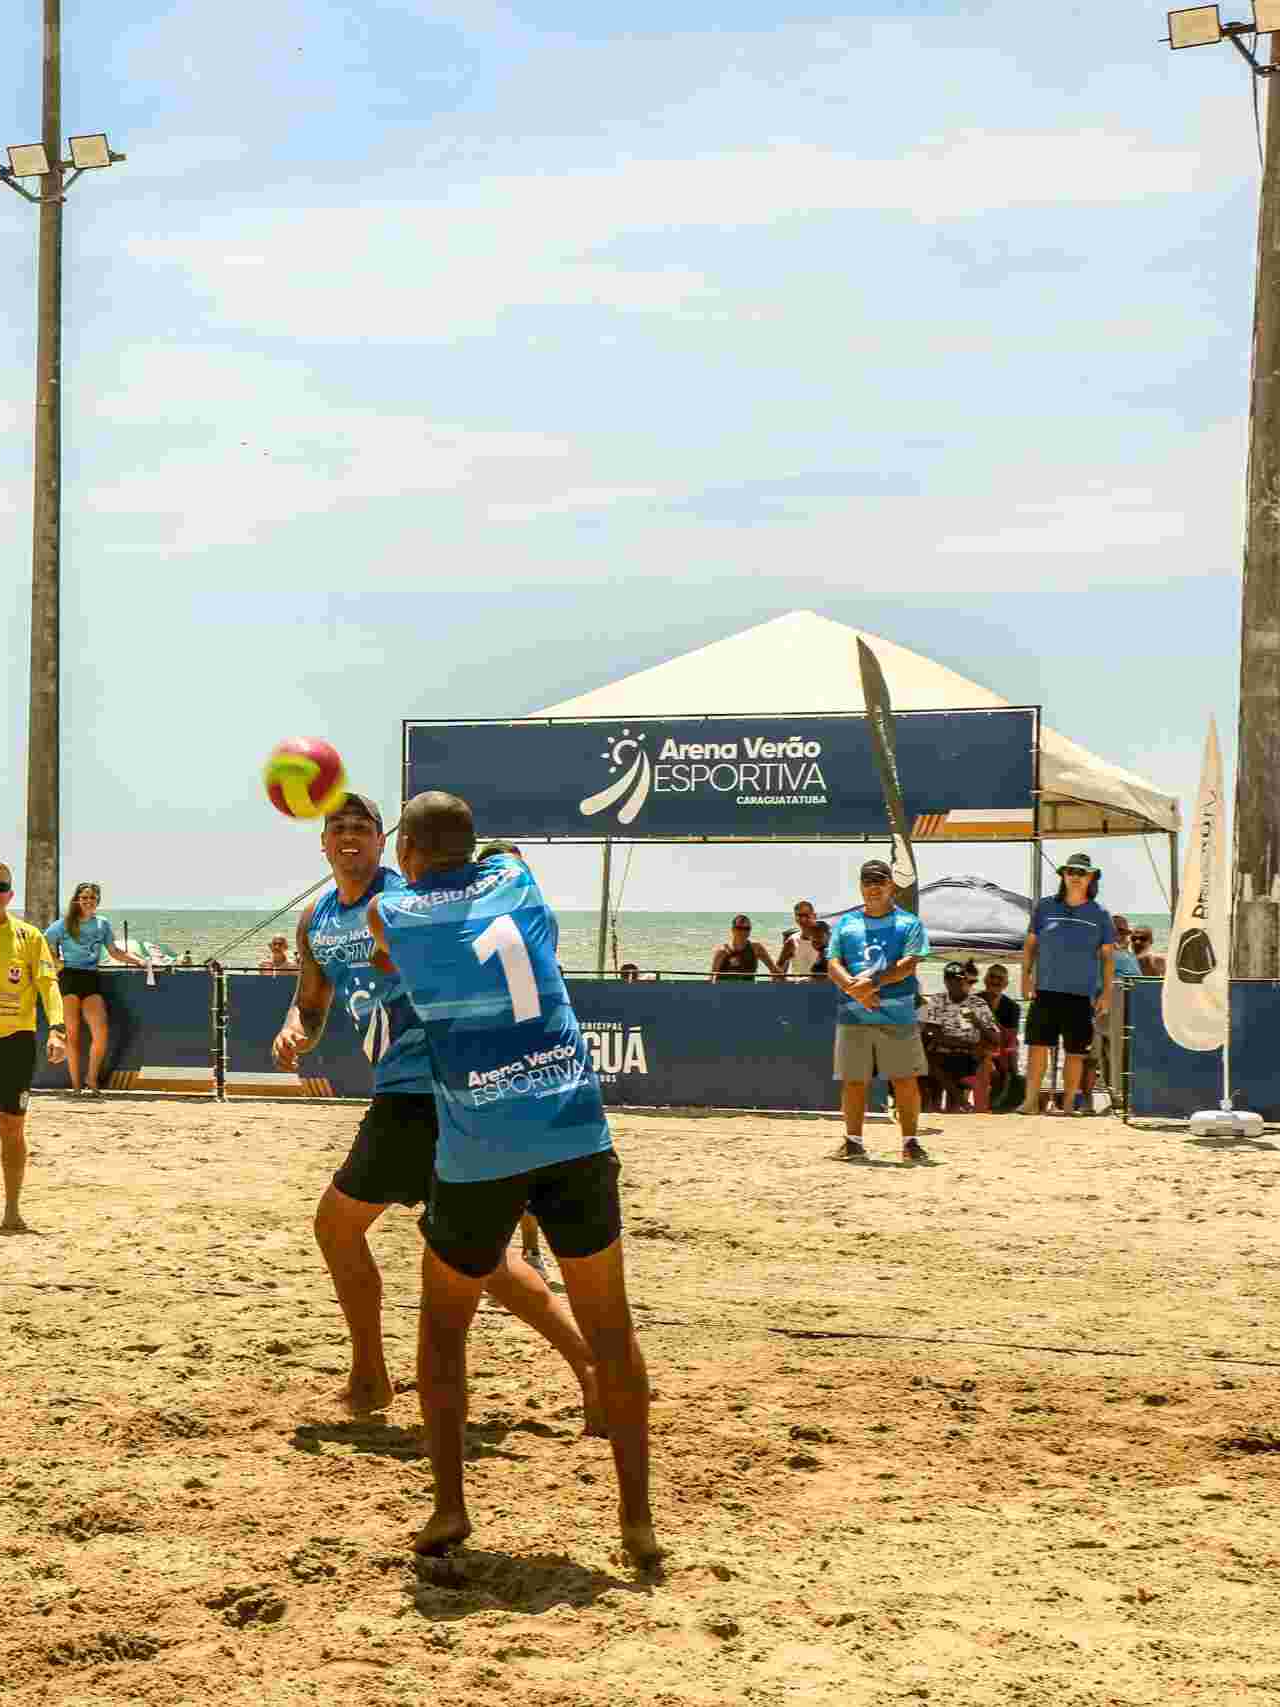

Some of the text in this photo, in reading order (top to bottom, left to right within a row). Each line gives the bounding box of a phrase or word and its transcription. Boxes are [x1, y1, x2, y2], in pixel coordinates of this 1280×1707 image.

[659, 736, 822, 760] Arena Verão
[654, 763, 827, 793] ESPORTIVA
[736, 796, 827, 805] CARAGUATATUBA
[472, 915, 542, 1024] 1
[468, 1059, 524, 1088] Arena
[525, 1043, 576, 1067] Verão
[582, 1026, 647, 1074] GUÁ
[471, 1059, 585, 1107] ESPORTIVA
